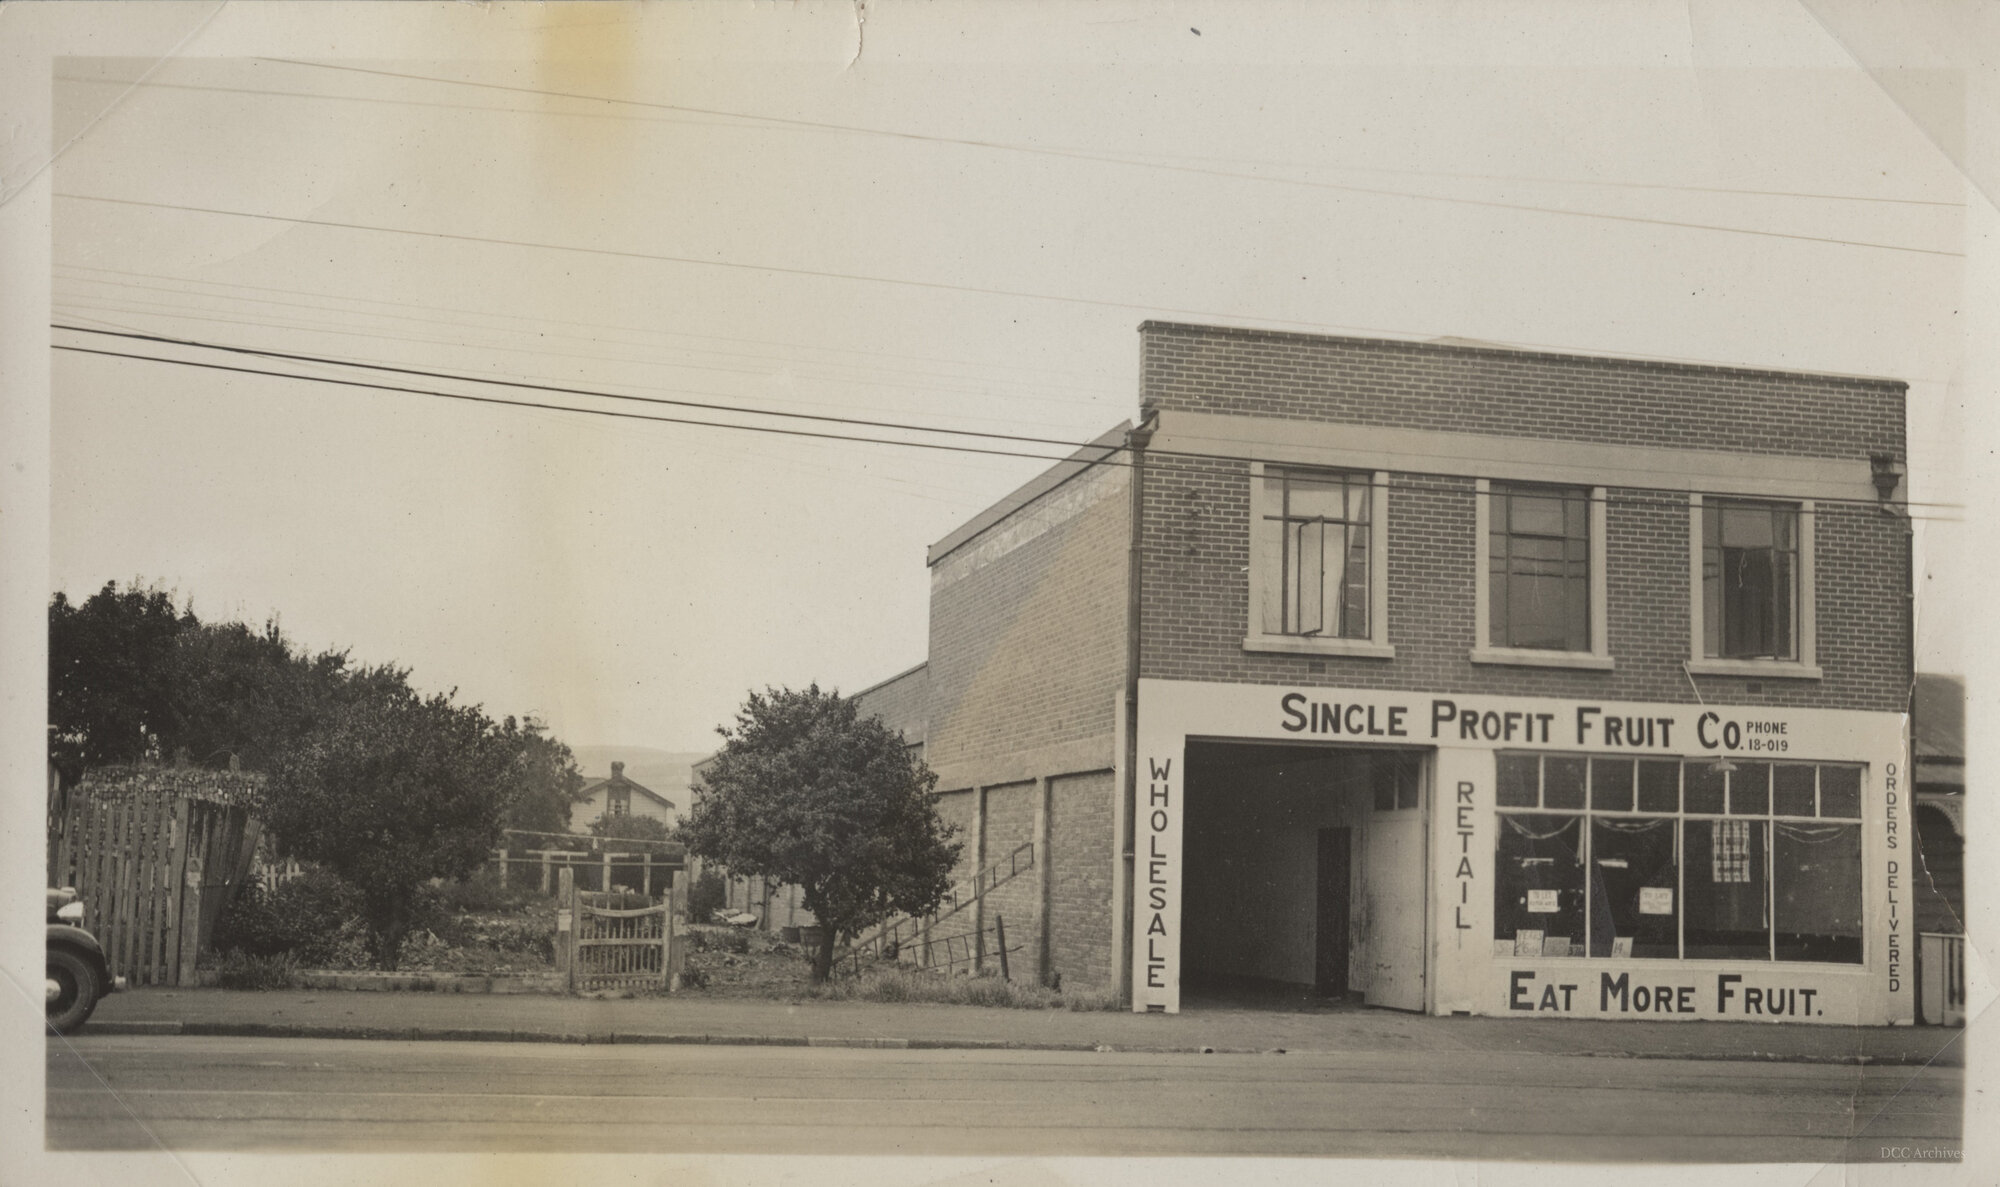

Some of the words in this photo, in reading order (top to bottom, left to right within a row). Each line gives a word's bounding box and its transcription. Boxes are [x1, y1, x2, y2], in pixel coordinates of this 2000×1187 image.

[1281, 693, 1408, 737] SINGLE
[1431, 700, 1555, 744] PROFIT
[1577, 706, 1675, 748] FRUIT
[1746, 721, 1788, 735] PHONE
[1748, 739, 1788, 752] 18-019
[1886, 762, 1898, 849] ORDERS
[1147, 757, 1171, 988] WHOLESALE
[1456, 781, 1475, 929] RETAIL
[1887, 861, 1900, 992] DELIVERED
[1509, 970, 1578, 1011] EAT
[1600, 972, 1696, 1013] MORE
[1717, 974, 1824, 1016] FRUIT.
